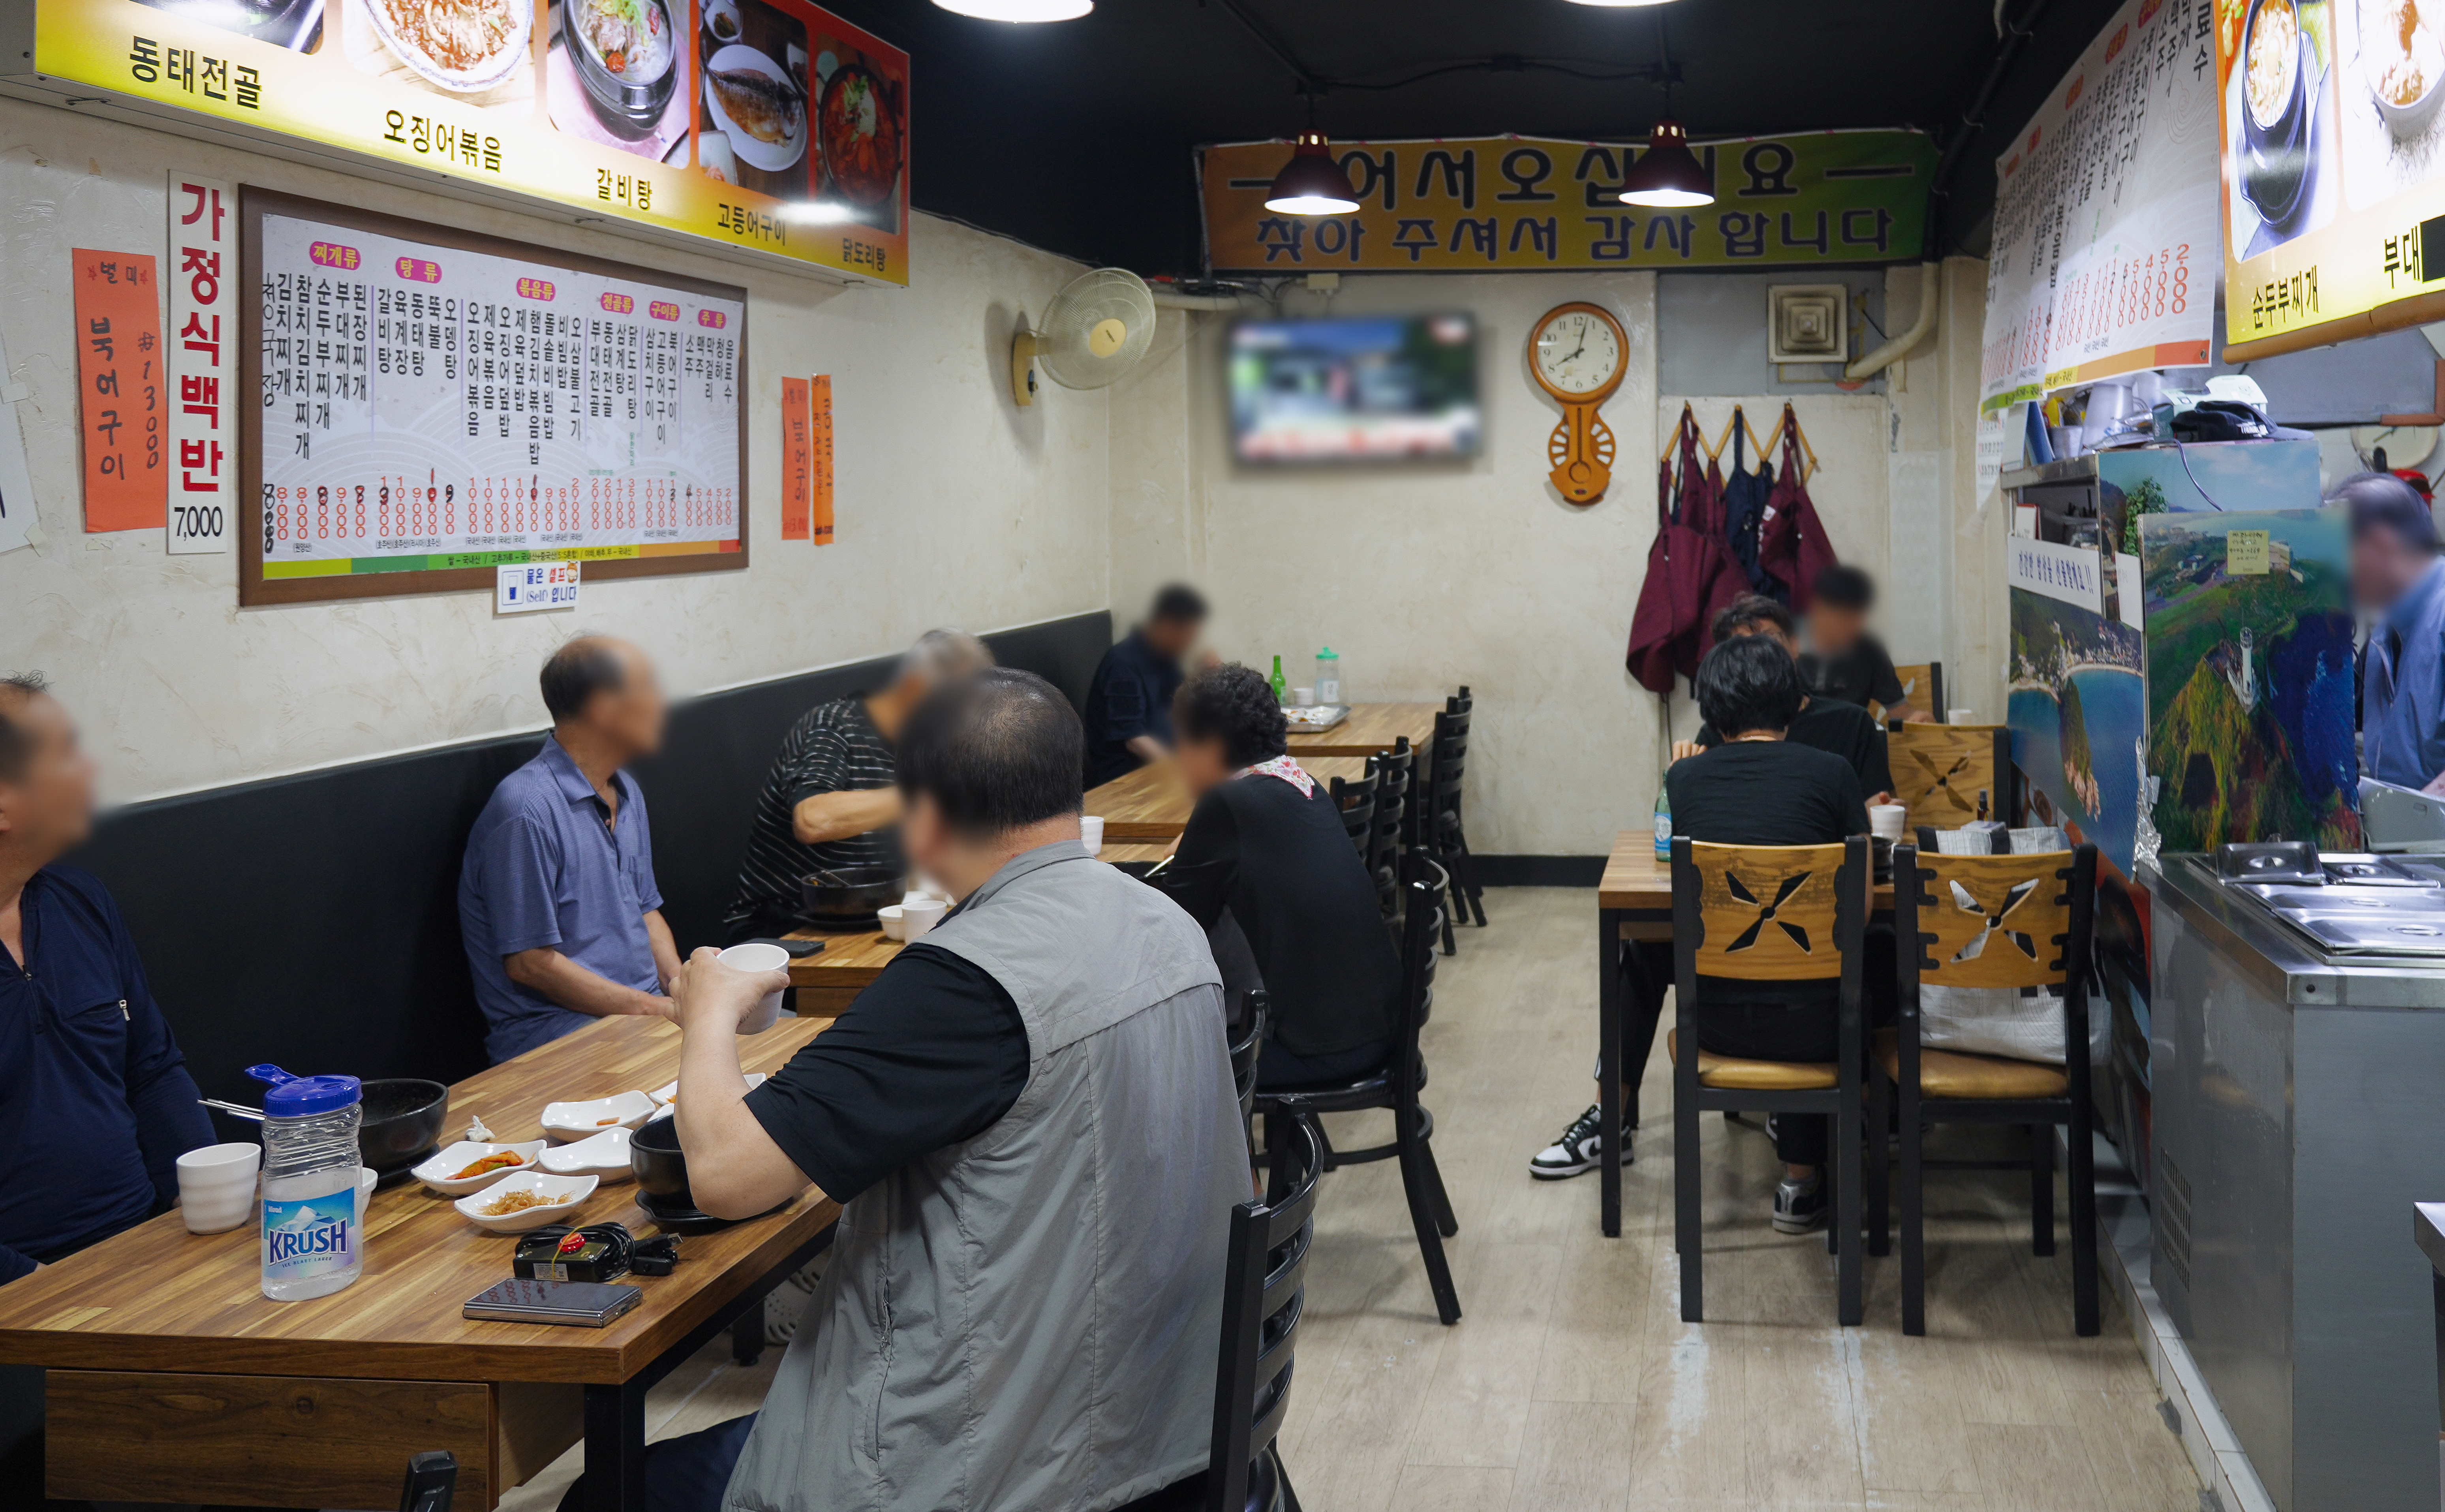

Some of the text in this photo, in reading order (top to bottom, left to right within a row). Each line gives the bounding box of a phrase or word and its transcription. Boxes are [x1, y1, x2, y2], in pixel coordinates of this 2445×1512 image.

[130, 36, 262, 111] 동태전골
[384, 110, 501, 173] 오징어볶음
[597, 168, 652, 211] 갈비탕
[1341, 143, 1799, 210] 어서오십요
[314, 244, 358, 268] 찌개류
[718, 203, 785, 246] 고등어구이
[1256, 217, 1365, 262] 찾아
[1392, 216, 1557, 261] 주셔서
[519, 279, 554, 299] 볶음류
[603, 294, 632, 313] 전골류
[652, 302, 678, 319] 구이류
[2252, 265, 2319, 330] 순두부찌개
[181, 182, 224, 492] 가정식백반
[276, 274, 291, 396] 김치찌개
[336, 281, 349, 400] 부대찌개
[353, 284, 367, 401] 된장찌개
[377, 288, 391, 374] 갈비탕
[411, 293, 424, 377] 동태탕
[445, 299, 456, 379] 오뎅탕
[557, 315, 568, 389] 비빔밥
[1544, 348, 1550, 357] 9
[1546, 334, 1556, 342] 10
[1559, 321, 1566, 330] 11
[1574, 317, 1583, 326] 12
[1592, 320, 1595, 329] 1
[1603, 331, 1609, 341] 2
[1607, 347, 1613, 357] 3
[295, 275, 312, 460] 참치김치찌개
[316, 279, 331, 430] 순두부찌개
[468, 302, 479, 436] 오징어볶음
[483, 304, 495, 410] 제육볶음
[500, 307, 511, 437] 오징어덮밥
[515, 309, 526, 411] 제육덮밥
[544, 313, 554, 440] 돌솥비빔밥
[571, 317, 581, 440] 오삼불고기
[590, 320, 600, 417] 부대전골
[603, 322, 612, 417] 동태전골
[616, 324, 626, 394] 삼계탕
[628, 326, 637, 419] 닭도리탕
[645, 328, 655, 421] 삼치구이
[668, 332, 678, 422] 북어구이
[685, 334, 693, 377] 소주
[706, 338, 714, 402] 막걸리
[715, 338, 724, 380] 청하
[725, 340, 733, 403] 음료수
[1548, 364, 1555, 373] 8
[1561, 376, 1567, 385] 7
[1576, 380, 1582, 389] 6
[1592, 375, 1598, 384] 5
[1605, 364, 1609, 372] 4
[90, 317, 125, 481] 북어구이
[657, 332, 666, 445] 고등어구이
[174, 506, 223, 541] 7,000
[528, 568, 565, 584] 물은 셀프
[552, 586, 576, 602] 입니다
[269, 1217, 349, 1266] KRUSH
